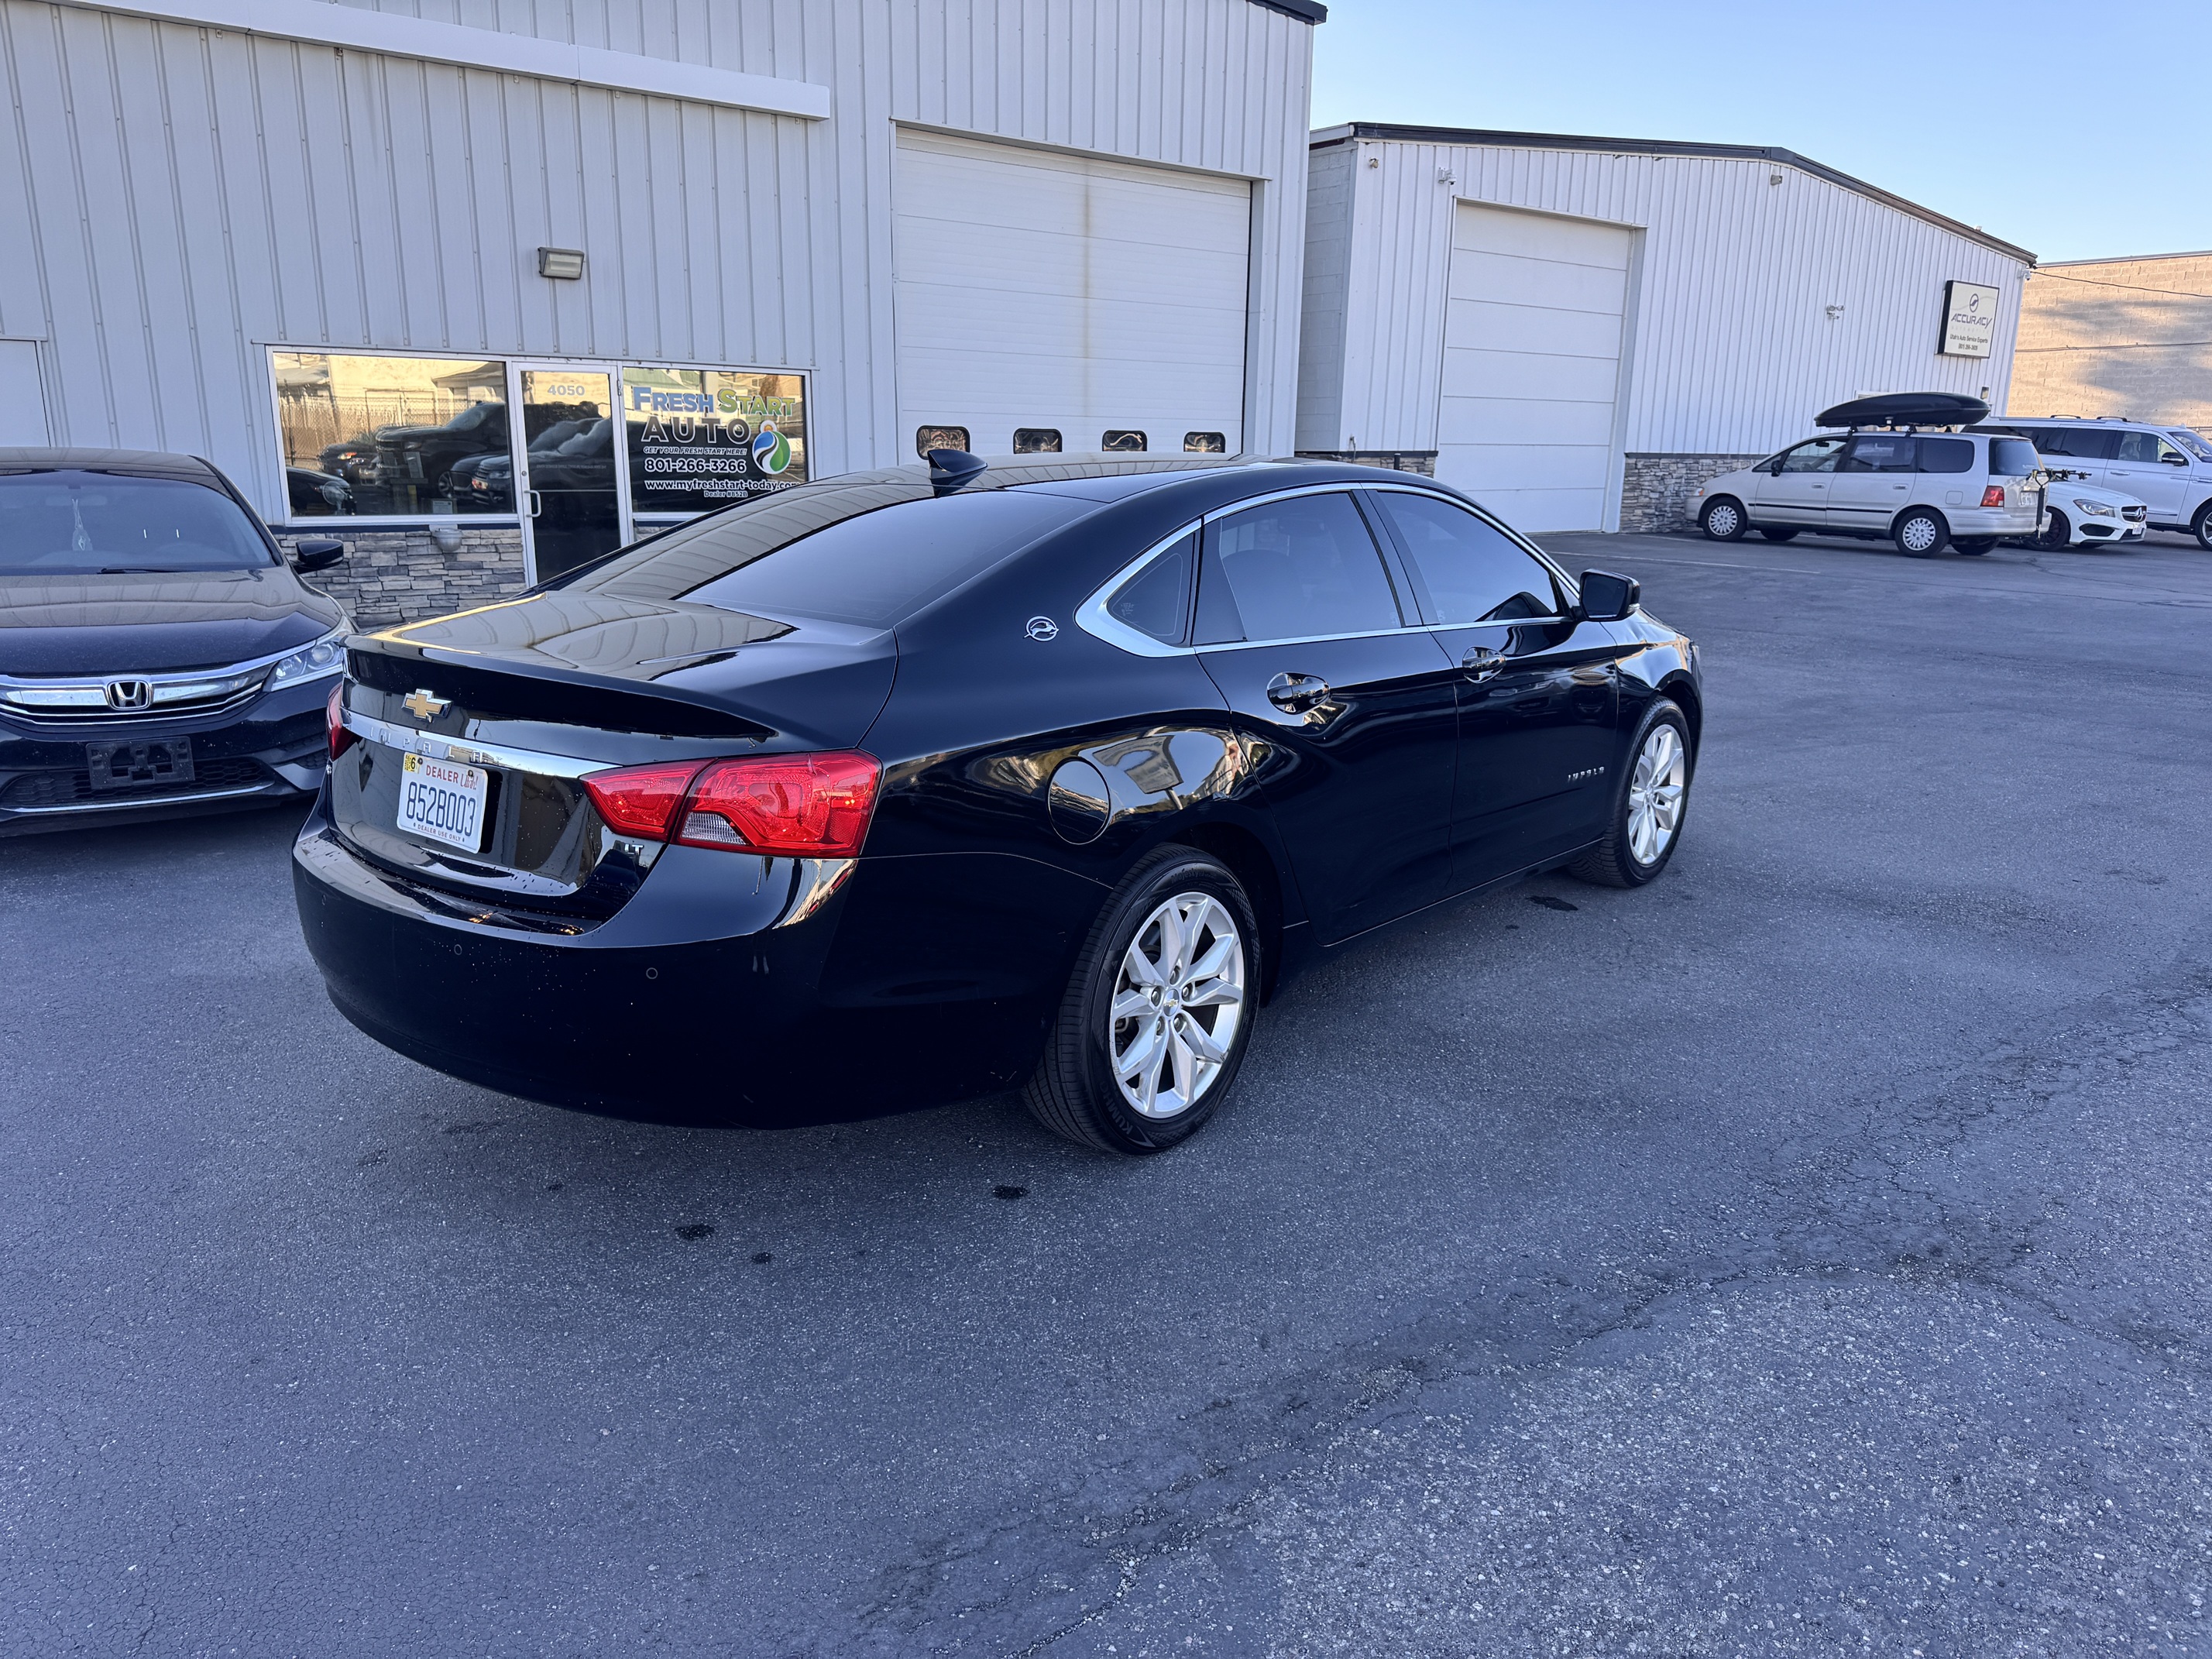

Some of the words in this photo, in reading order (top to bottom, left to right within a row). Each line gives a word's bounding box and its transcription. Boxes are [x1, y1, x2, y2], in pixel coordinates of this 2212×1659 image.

[1951, 313, 1993, 329] ACCURACY
[548, 384, 586, 396] 4050
[632, 386, 714, 414] FRESH
[717, 388, 795, 417] START
[641, 415, 751, 445] AUTO
[680, 447, 703, 455] FRESH
[644, 458, 747, 473] 801-266-3266
[426, 764, 459, 783] DEALER
[407, 781, 476, 836] 852B003
[417, 824, 436, 834] DEALER
[449, 833, 461, 842] ONLY
[624, 843, 644, 856] LT
[1099, 1080, 1134, 1135] KUMHO
